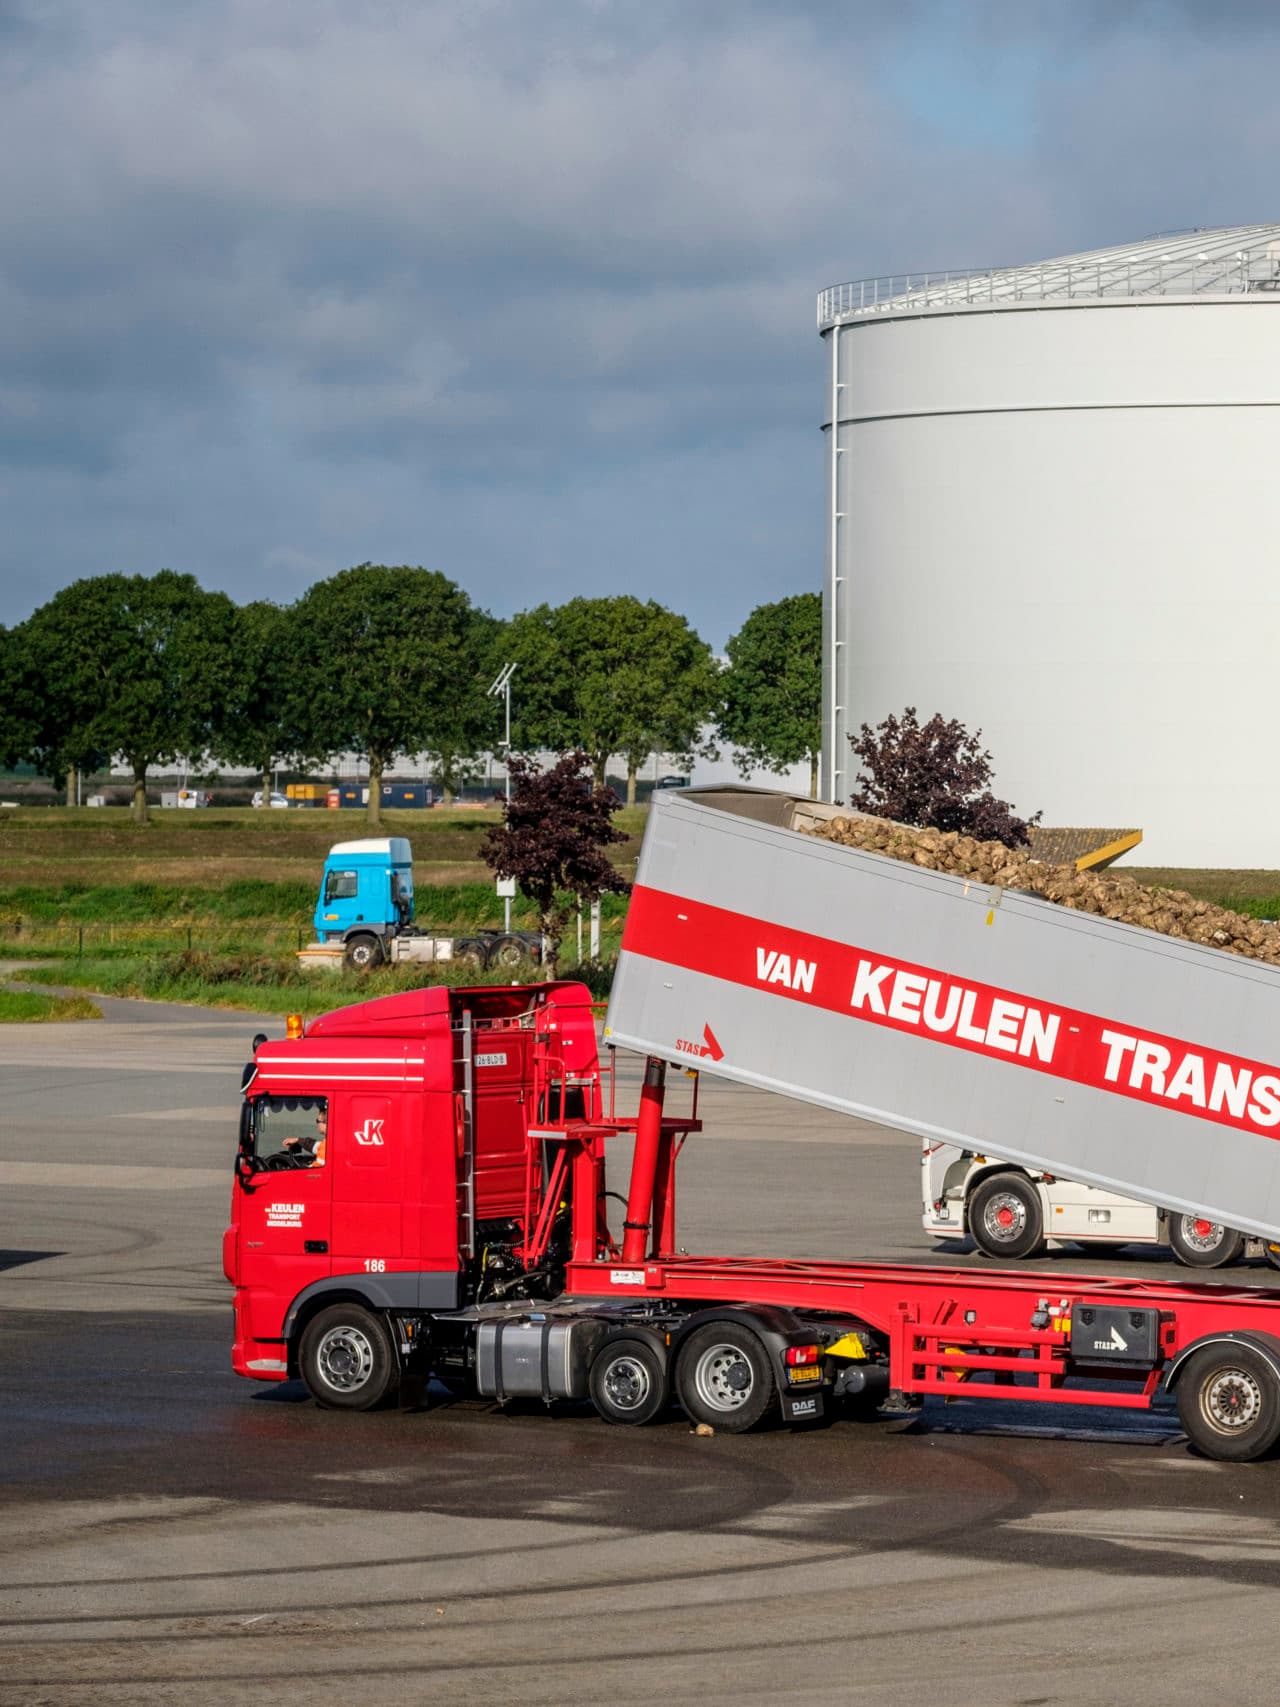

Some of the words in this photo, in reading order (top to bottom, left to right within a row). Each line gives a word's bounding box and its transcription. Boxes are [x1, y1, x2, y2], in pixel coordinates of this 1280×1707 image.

[756, 947, 817, 994] VAN
[851, 960, 1061, 1063] KEULEN
[676, 1039, 700, 1056] STAS
[271, 1203, 305, 1214] KEULEN
[363, 1258, 386, 1273] 186
[1093, 1340, 1112, 1350] STAS
[791, 1399, 816, 1411] DAF
